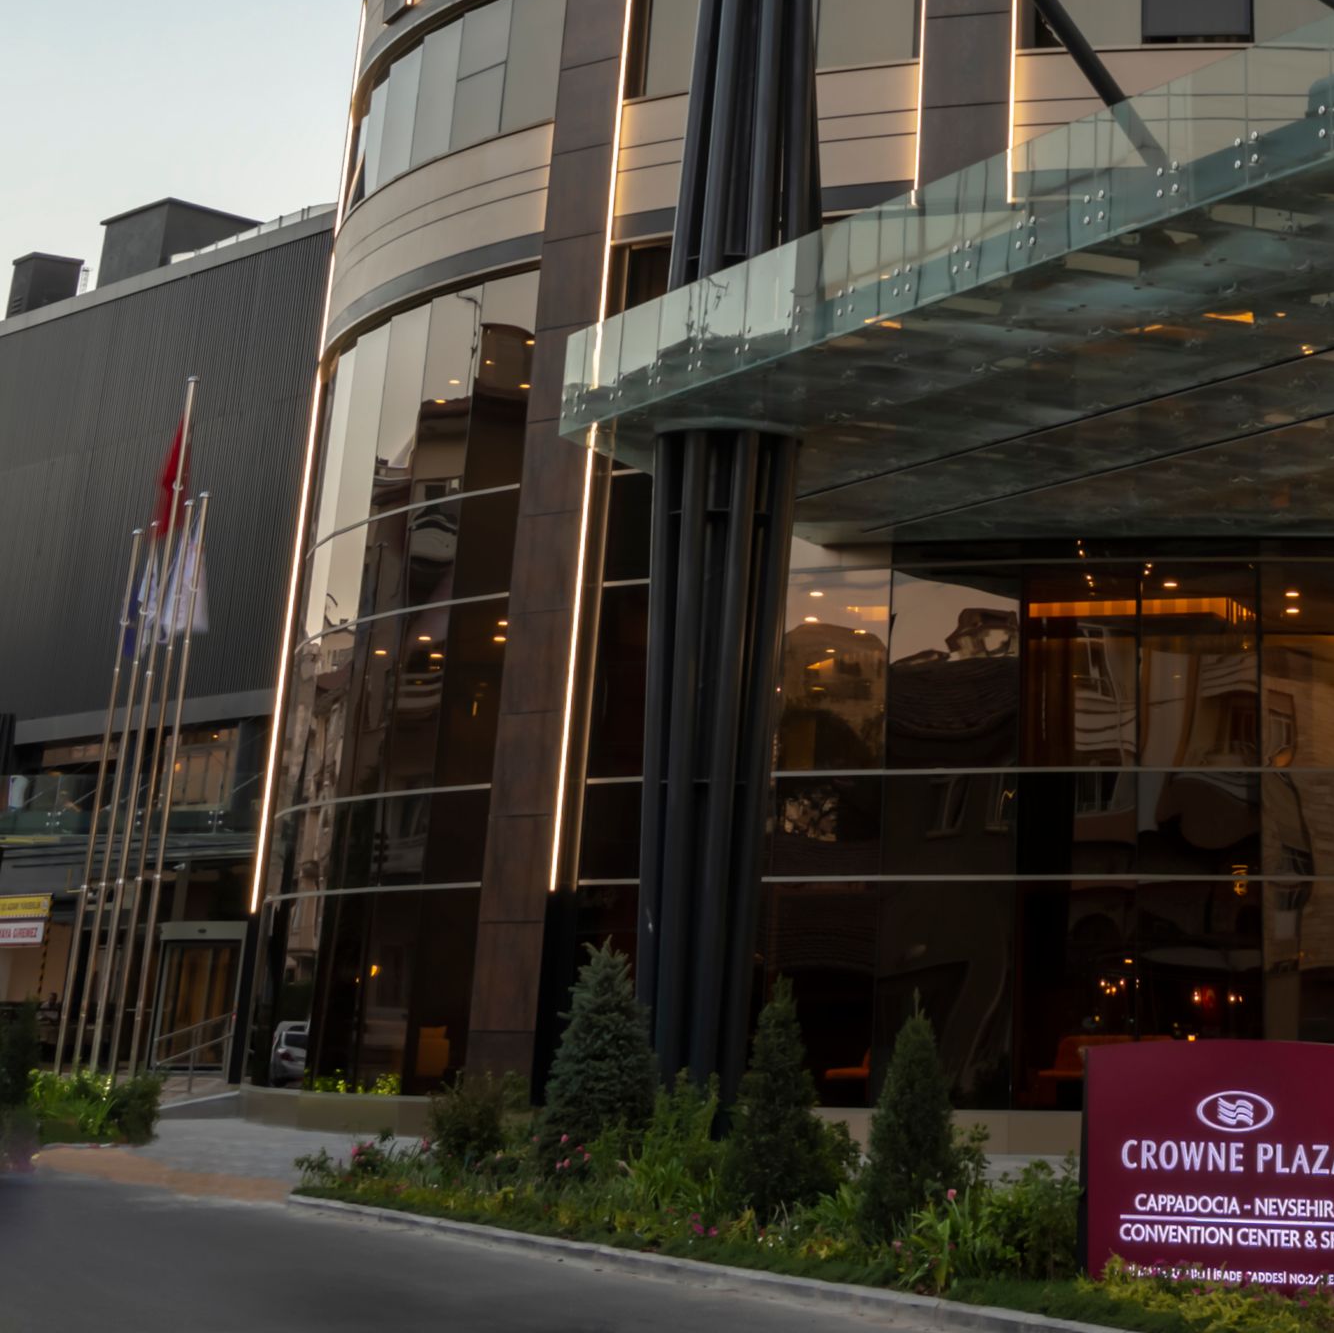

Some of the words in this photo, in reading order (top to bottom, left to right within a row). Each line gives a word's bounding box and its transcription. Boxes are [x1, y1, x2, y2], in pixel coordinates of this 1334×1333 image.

[1121, 1139, 1244, 1172] CROWNE
[1134, 1193, 1240, 1216] CAPPADOCIA
[1119, 1223, 1233, 1245] CONVENTION
[1236, 1226, 1301, 1248] CENTER
[1303, 1230, 1317, 1248] &
